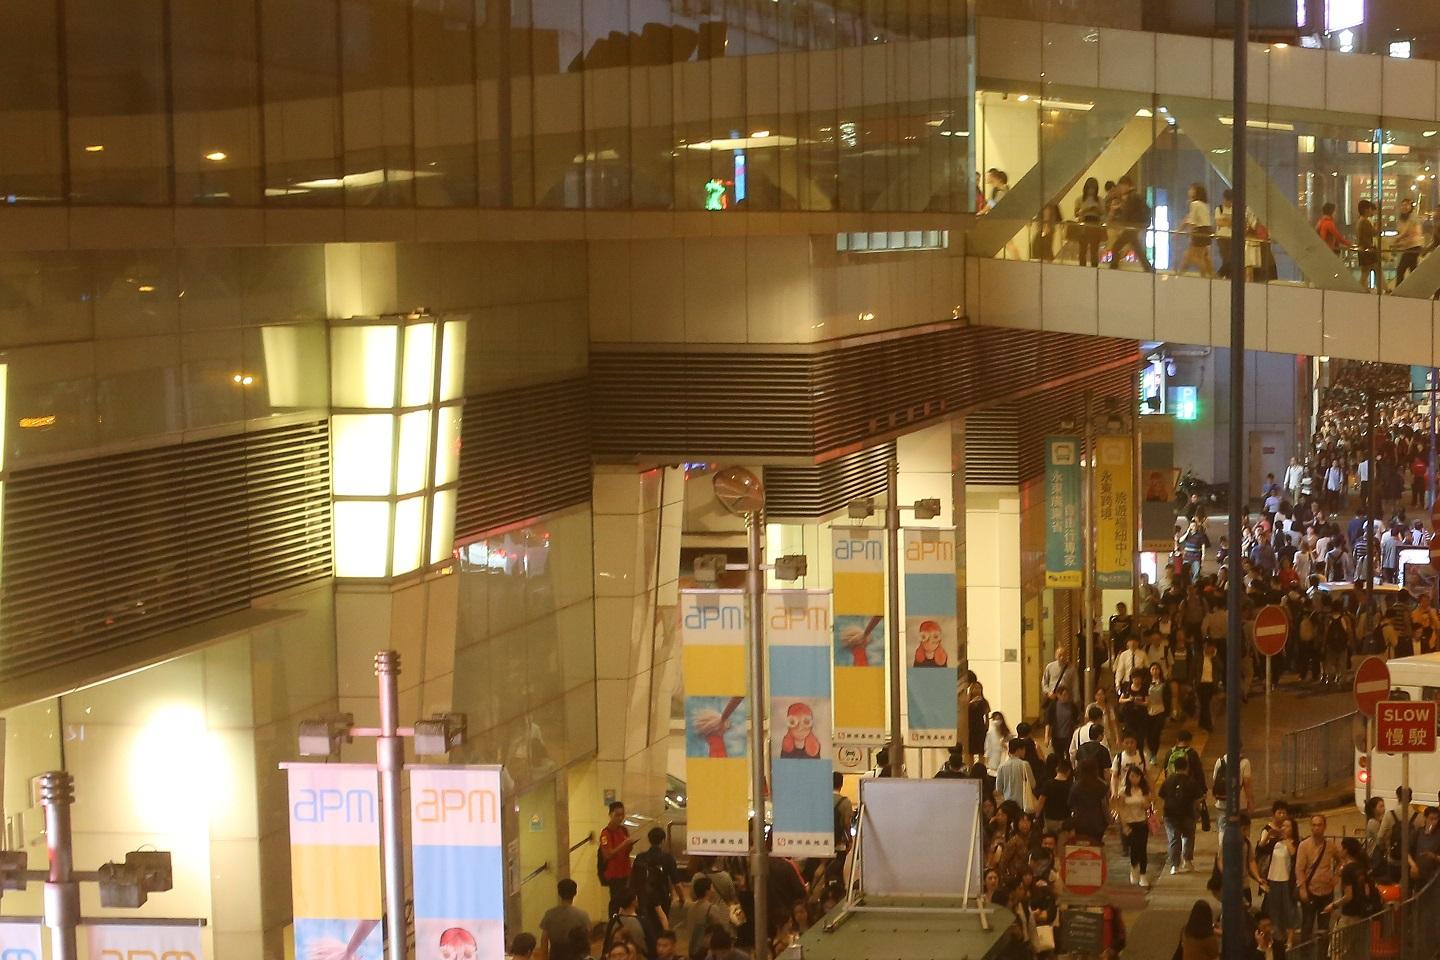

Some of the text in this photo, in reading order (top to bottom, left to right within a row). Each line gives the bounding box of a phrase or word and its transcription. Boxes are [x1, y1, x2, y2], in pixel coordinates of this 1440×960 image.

[1383, 707, 1431, 723] SLOW
[1385, 728, 1428, 747] 慢駛
[293, 787, 377, 824] apm
[415, 787, 499, 824] apm
